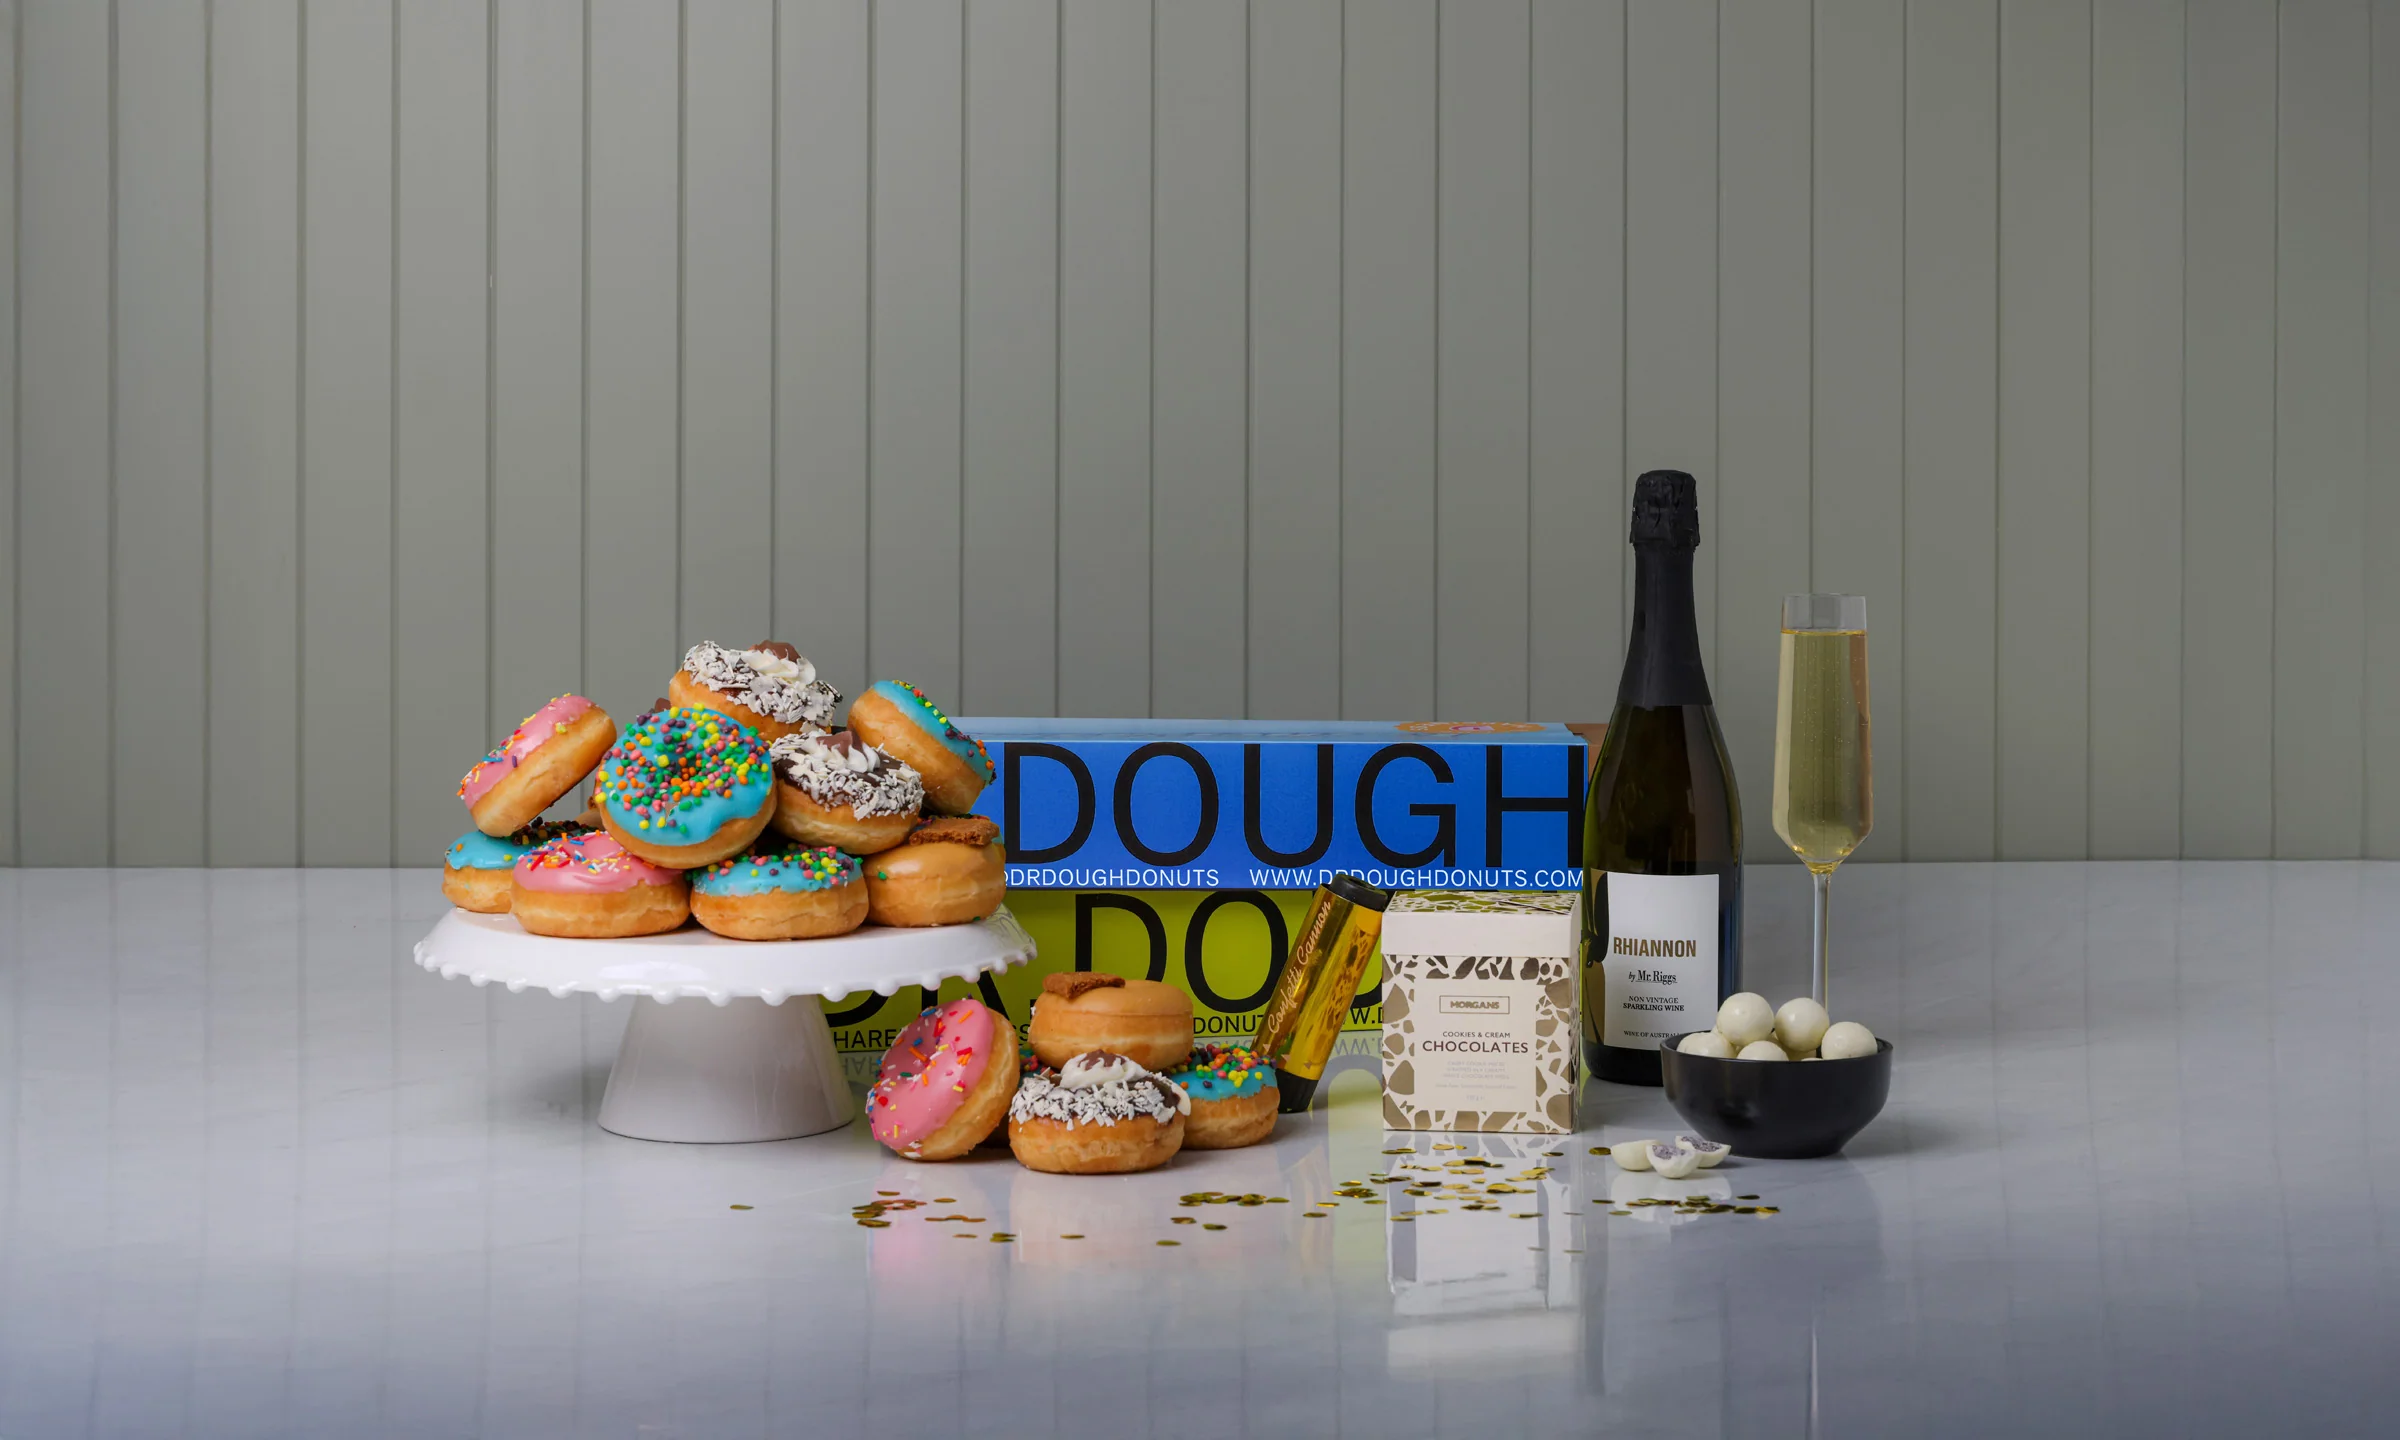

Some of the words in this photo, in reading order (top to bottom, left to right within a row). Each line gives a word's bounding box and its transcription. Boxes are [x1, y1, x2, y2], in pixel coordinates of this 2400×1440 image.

[1004, 742, 1584, 868] DOUGH
[1003, 868, 1219, 887] DRDOUGHDONUTS
[1613, 936, 1697, 958] RHIANNON
[1268, 966, 1302, 1034] Confetti
[1296, 901, 1331, 966] Cannon
[1628, 971, 1636, 982] by
[1653, 970, 1677, 985] Riggs
[1450, 1000, 1500, 1009] MORGANS
[1628, 995, 1645, 1003] NON
[1646, 996, 1679, 1004] VINTAGE
[1623, 1003, 1663, 1012] SPARKLING
[1665, 1004, 1685, 1012] WINE
[1484, 1031, 1511, 1039] CREAM
[1422, 1040, 1529, 1054] CHOCOLATES
